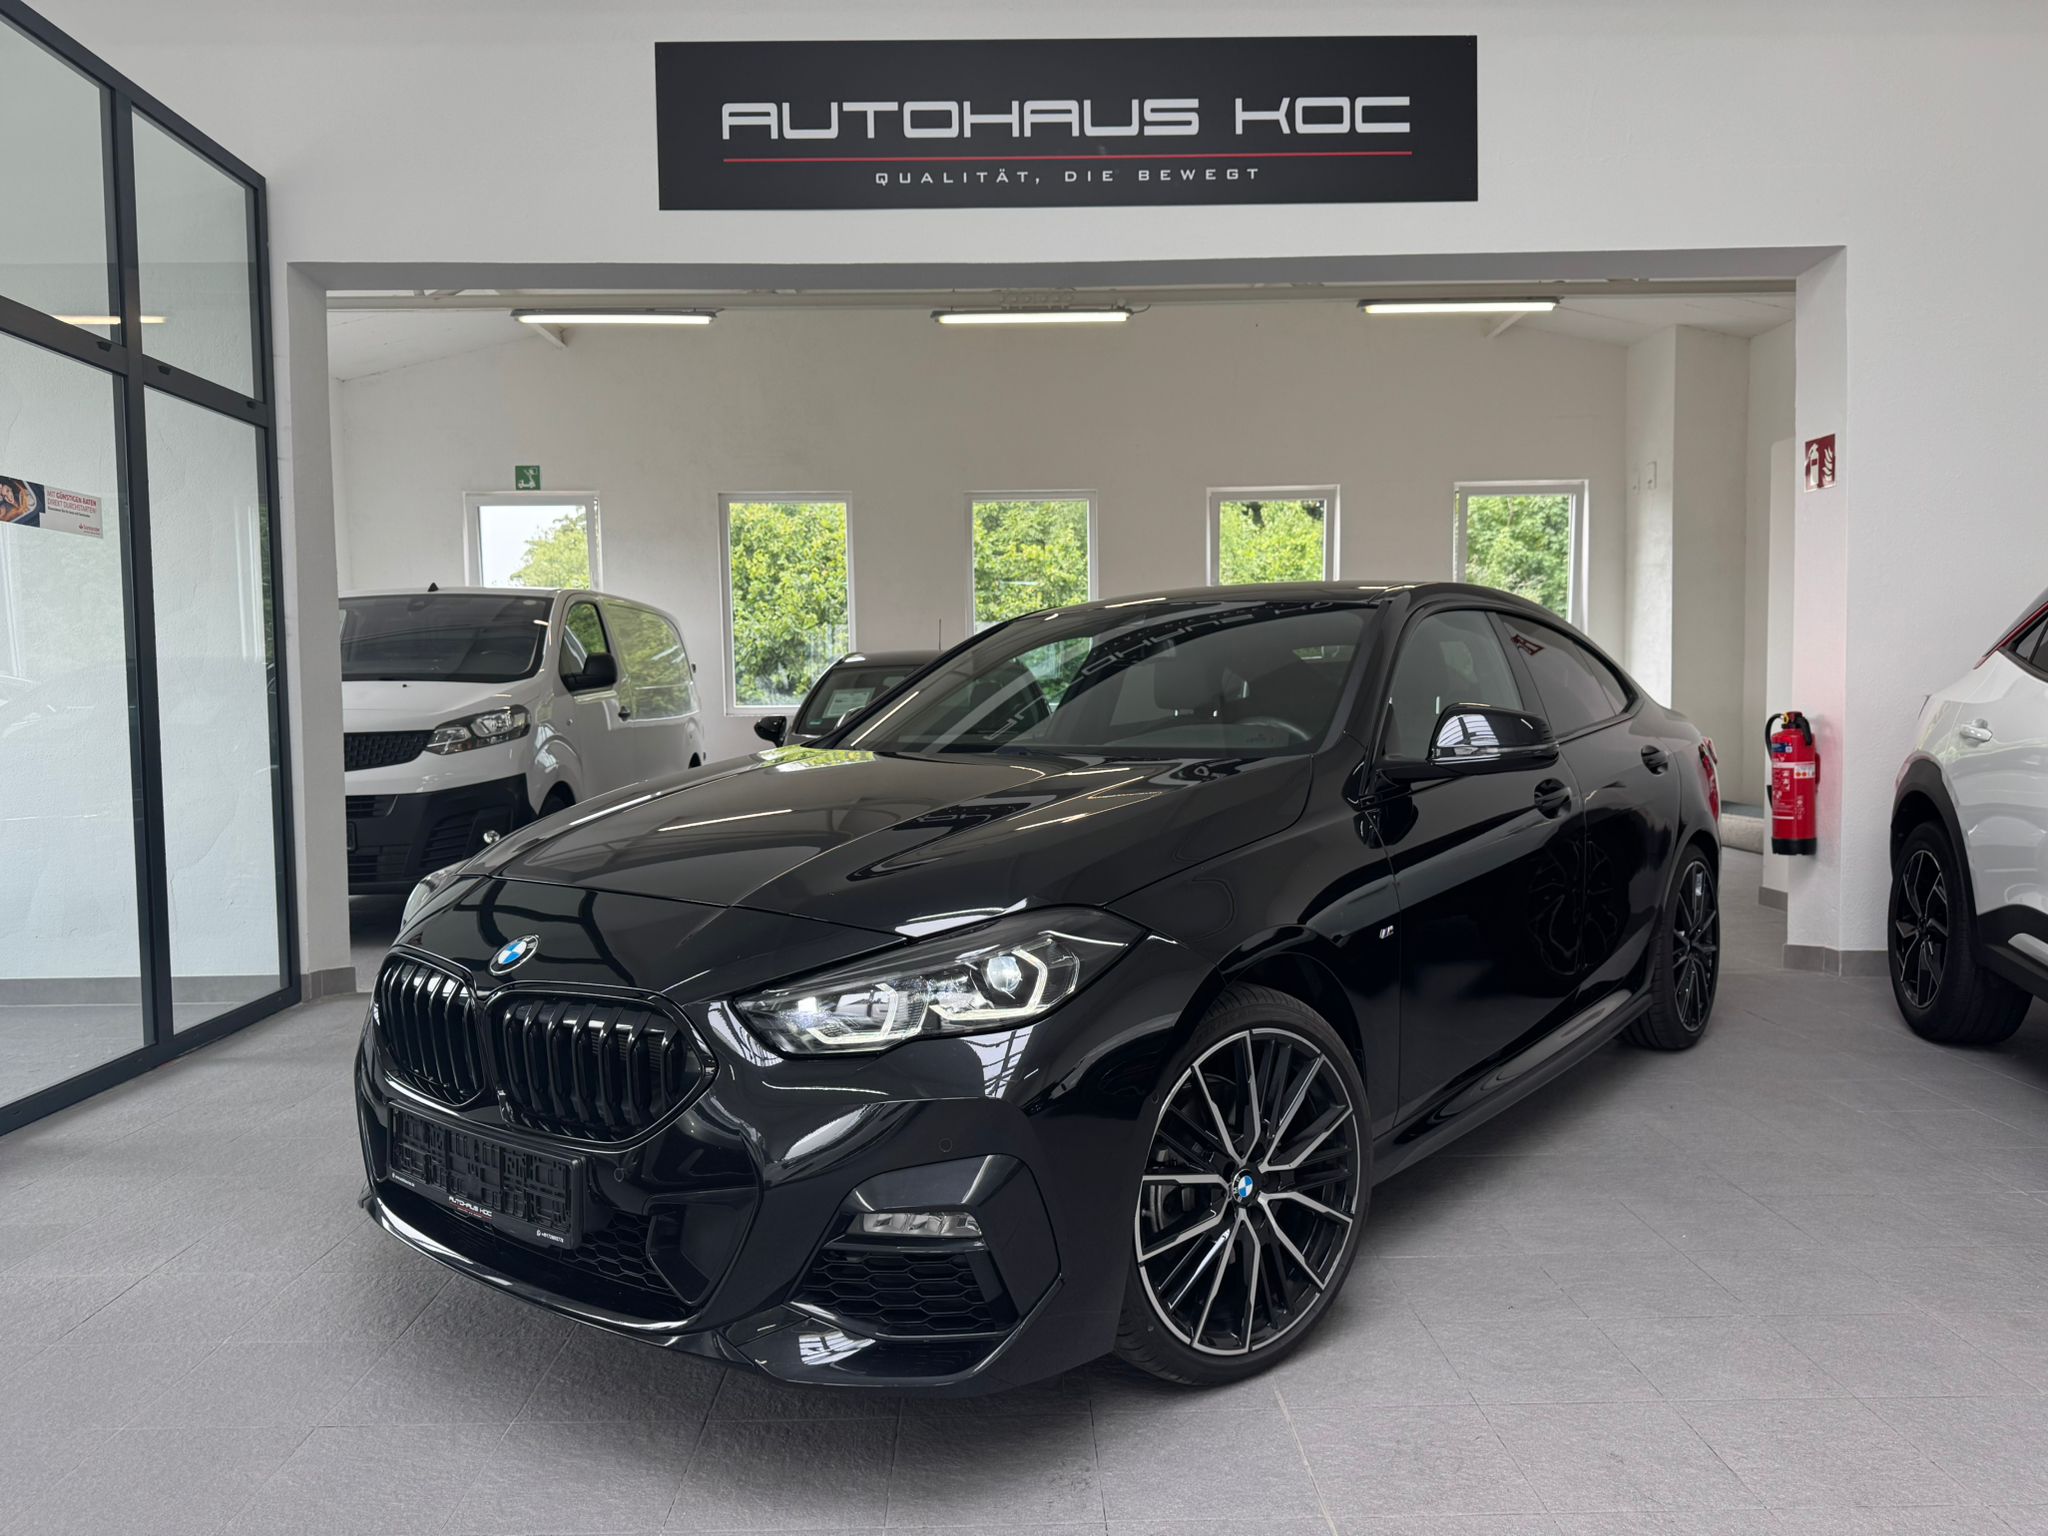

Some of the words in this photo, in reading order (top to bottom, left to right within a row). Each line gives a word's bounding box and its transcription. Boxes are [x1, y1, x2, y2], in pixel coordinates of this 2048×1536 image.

[721, 98, 1200, 140] AUTOHAUS
[1234, 96, 1411, 135] KOC
[875, 167, 1040, 187] QUALITÄT,
[1064, 170, 1114, 183] DIE
[1138, 167, 1259, 182] BEWEGT
